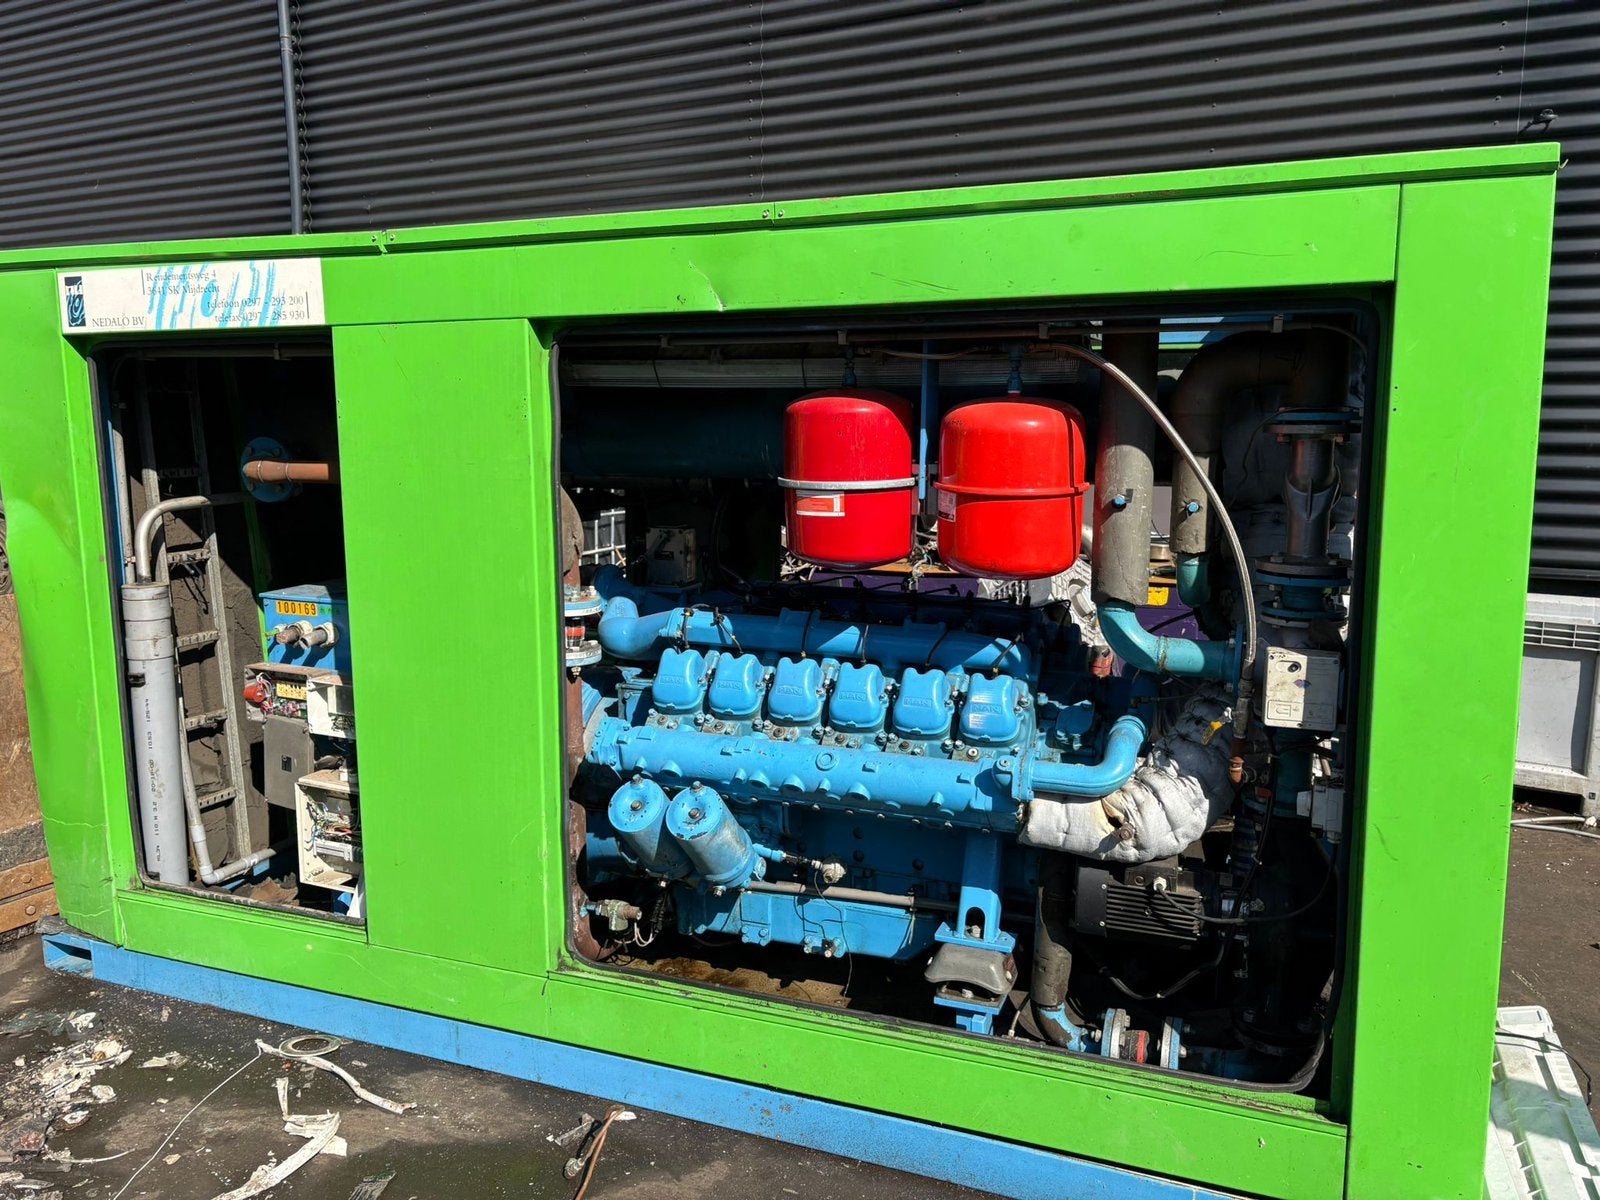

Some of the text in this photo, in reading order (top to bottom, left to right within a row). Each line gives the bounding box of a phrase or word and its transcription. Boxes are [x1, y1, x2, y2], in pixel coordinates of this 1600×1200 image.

[146, 269, 216, 281] Rendementsweg 4
[147, 283, 220, 296] 3641 SK Mijdrecht
[207, 298, 239, 309] telefoon
[241, 297, 261, 307] 0297
[271, 296, 286, 306] 293
[288, 295, 304, 305] 200
[92, 316, 145, 327] NEDALO BV
[215, 312, 241, 322] telefax
[242, 311, 262, 321] 0297
[272, 310, 287, 320] 285
[289, 310, 305, 320] 930
[277, 601, 316, 615] 100169
[972, 703, 1001, 713] MAN
